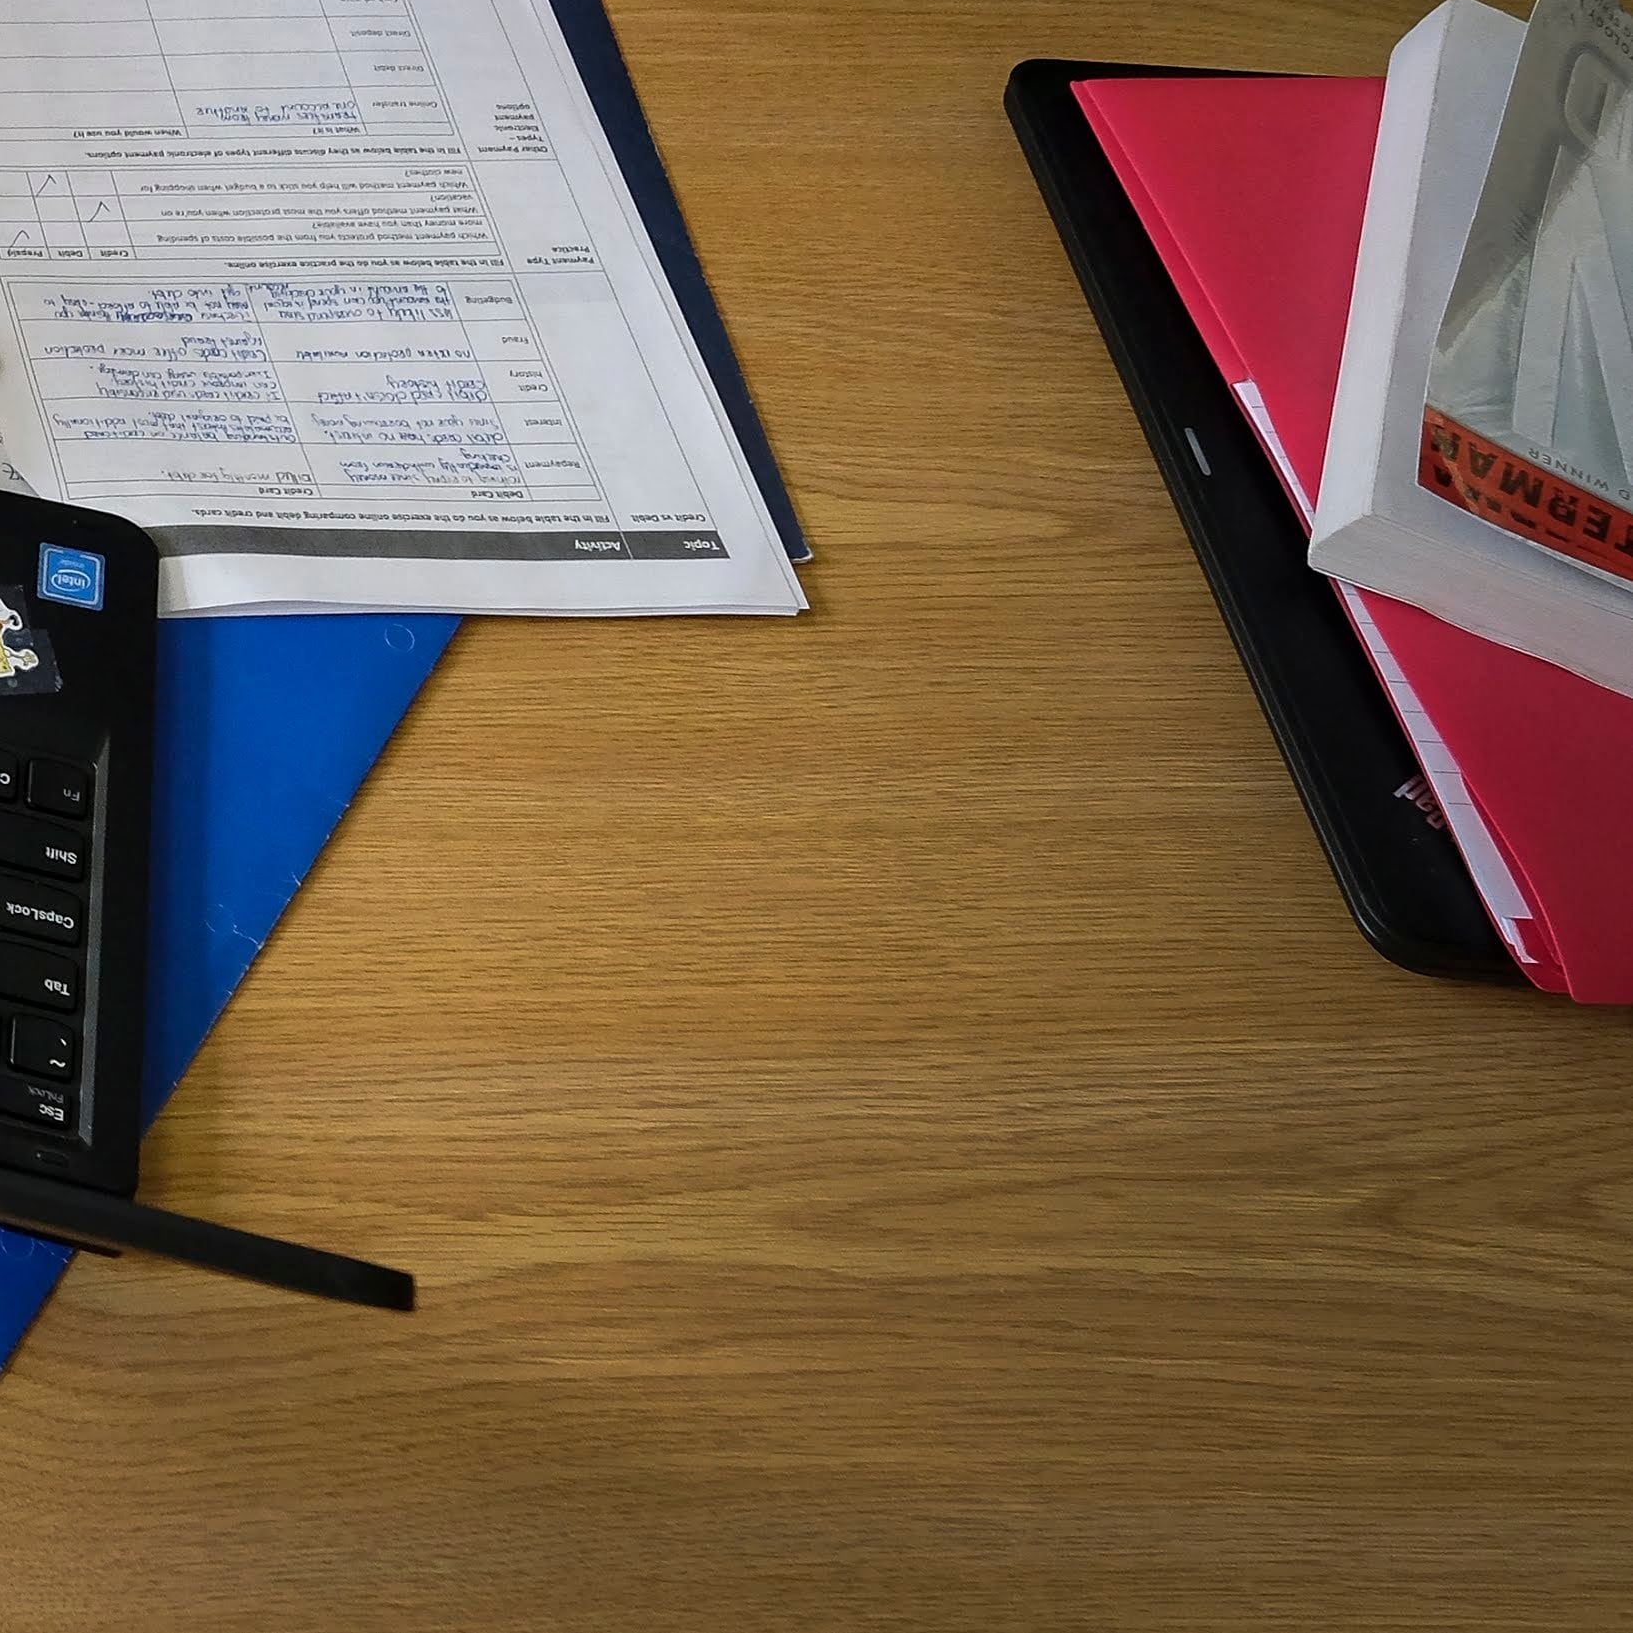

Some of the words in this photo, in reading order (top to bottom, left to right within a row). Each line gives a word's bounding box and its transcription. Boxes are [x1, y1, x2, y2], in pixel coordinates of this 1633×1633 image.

[57, 249, 84, 259] Debit
[99, 249, 129, 259] Credit
[500, 336, 531, 345] Fraud
[518, 383, 550, 393] Credit
[522, 419, 564, 428] Interest
[522, 459, 582, 471] Repayment
[1527, 448, 1609, 490] WINNER
[257, 486, 282, 496] Card
[282, 486, 314, 496] Credit
[469, 490, 494, 499] Card
[494, 490, 524, 499] Debit
[631, 514, 660, 524] Debit
[673, 513, 706, 523] Credit
[573, 538, 621, 551] Activity
[681, 538, 721, 551] Topic
[57, 574, 86, 589] intel
[64, 789, 80, 801] Fn
[46, 847, 77, 864] Shift
[7, 902, 74, 928] CapsLock
[45, 979, 70, 996] Tab
[39, 1100, 63, 1121] Esc
